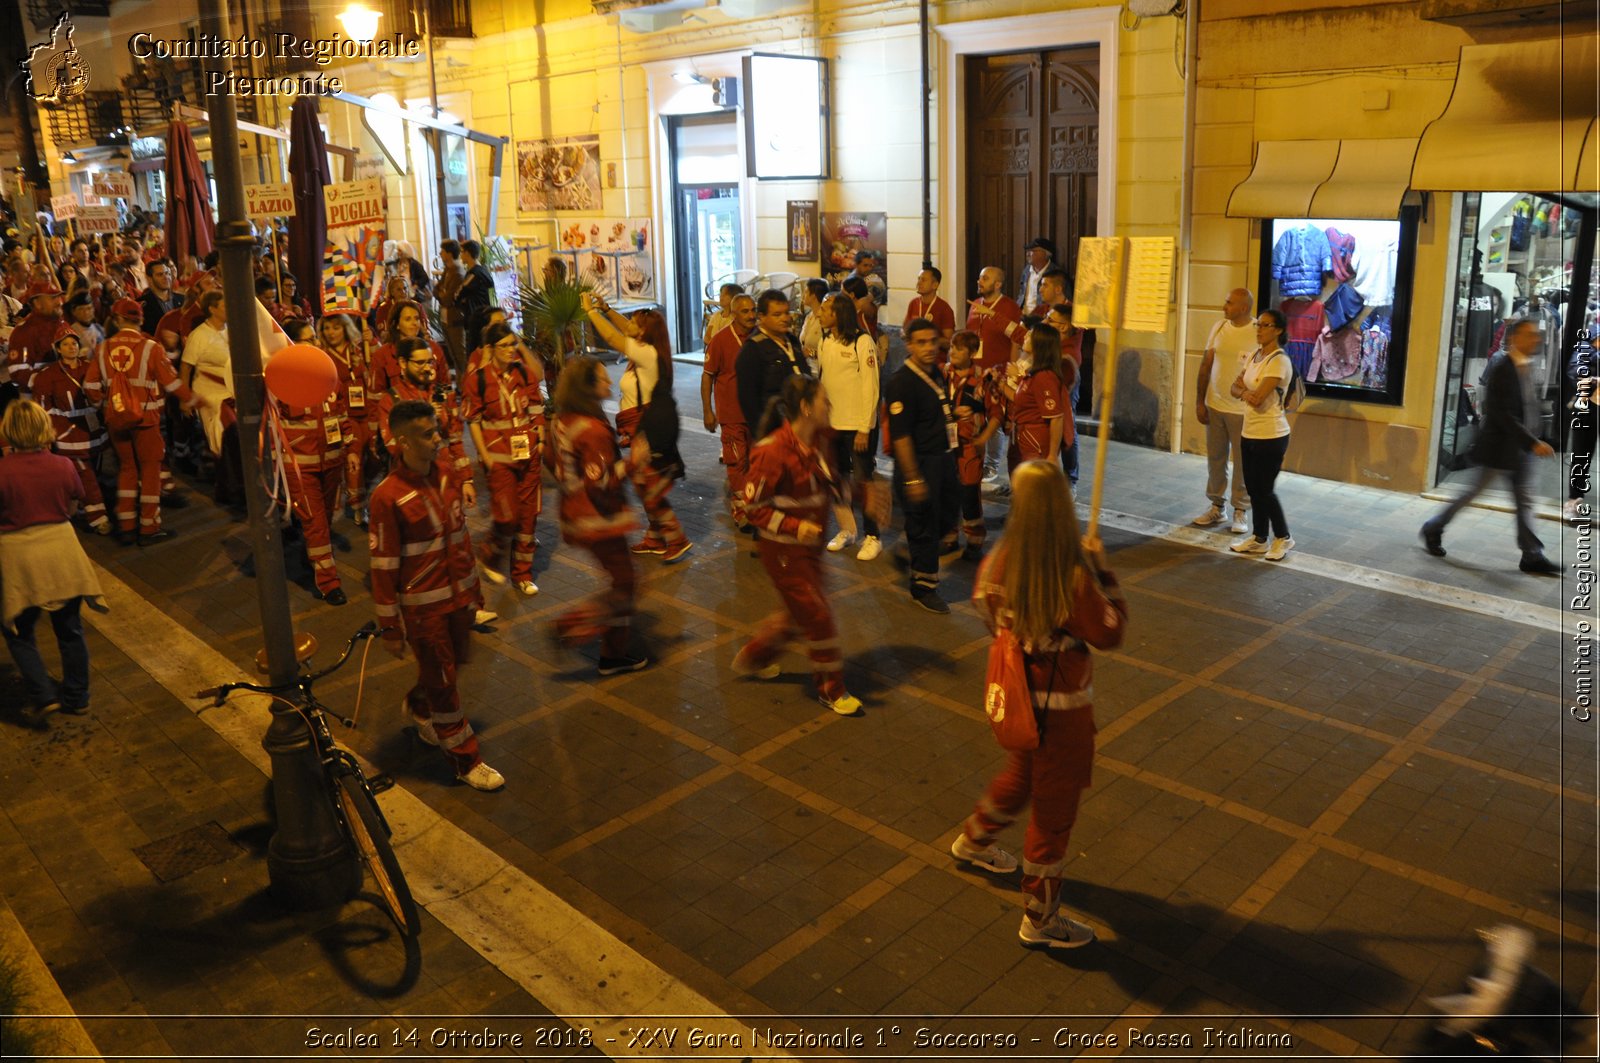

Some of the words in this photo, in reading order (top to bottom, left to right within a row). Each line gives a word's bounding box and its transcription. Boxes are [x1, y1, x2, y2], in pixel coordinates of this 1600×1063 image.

[248, 198, 293, 215] LAZIO
[329, 198, 381, 224] PUGLIA
[79, 218, 118, 232] VENETO
